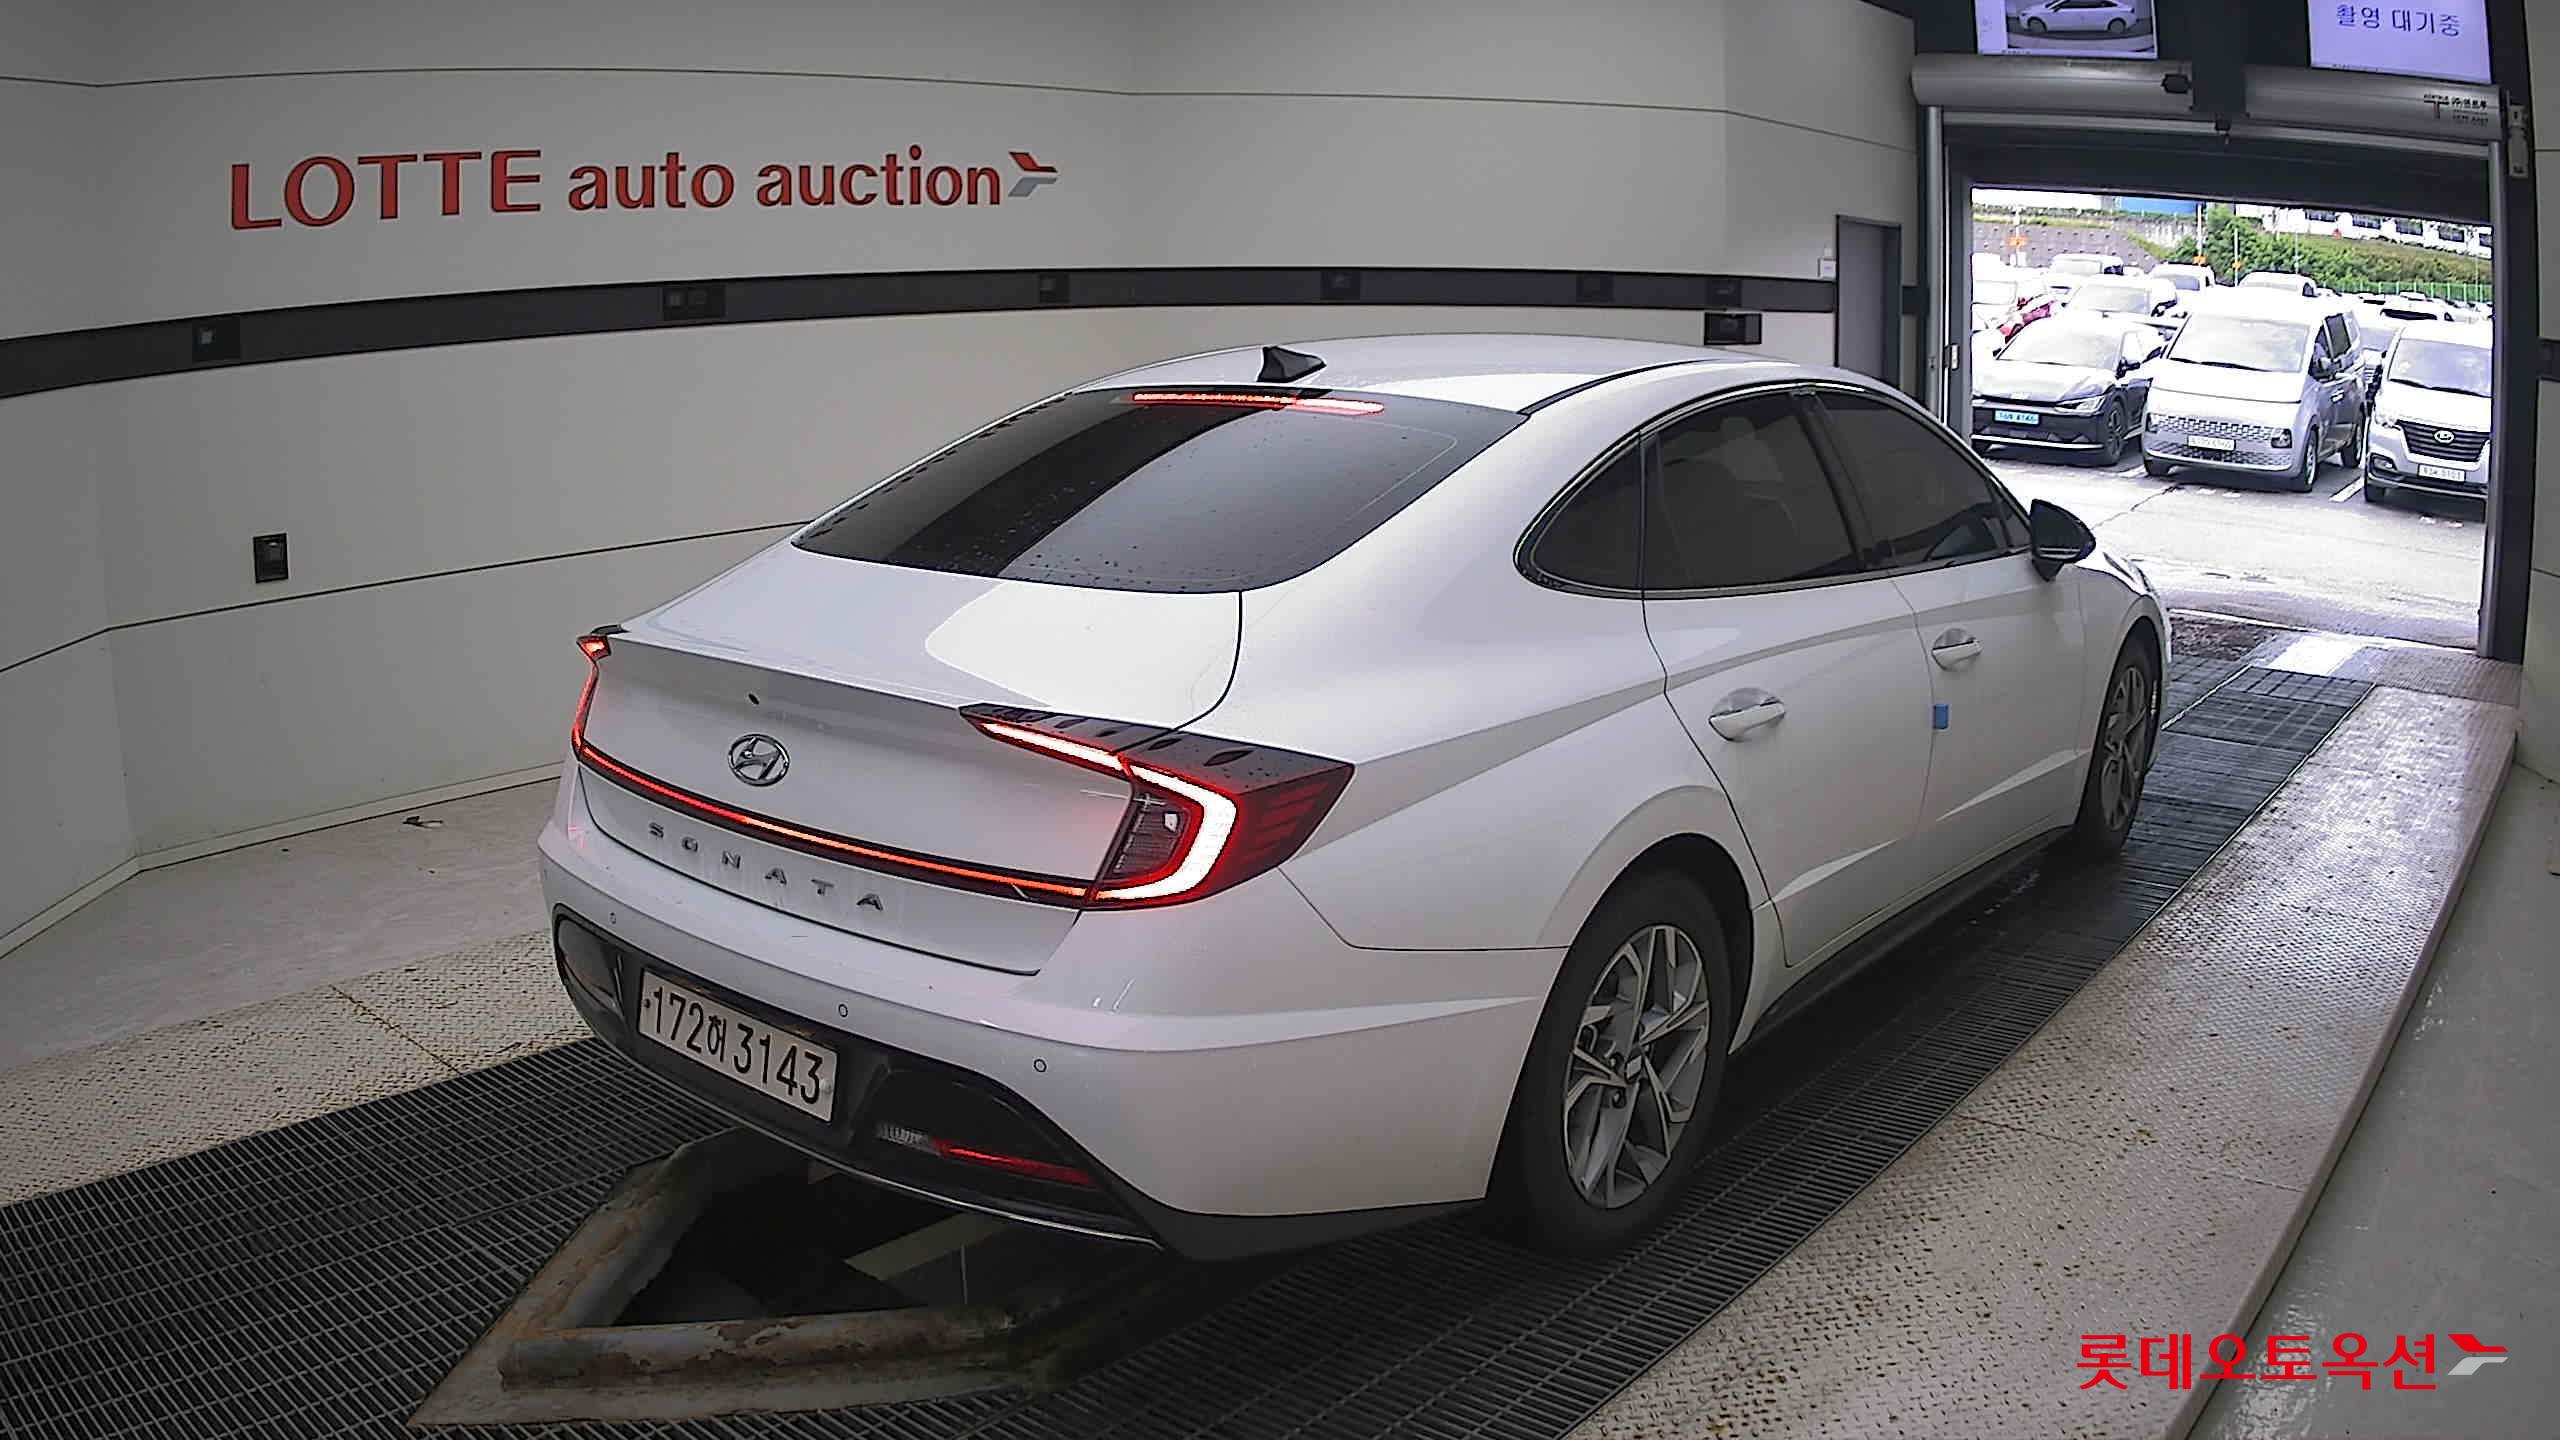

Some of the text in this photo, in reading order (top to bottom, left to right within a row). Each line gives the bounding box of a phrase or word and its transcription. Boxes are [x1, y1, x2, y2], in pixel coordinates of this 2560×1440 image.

[2337, 4, 2460, 37] 촬영 대기중
[230, 145, 1001, 230] LOTTE auto auction
[648, 821, 884, 912] SONATA
